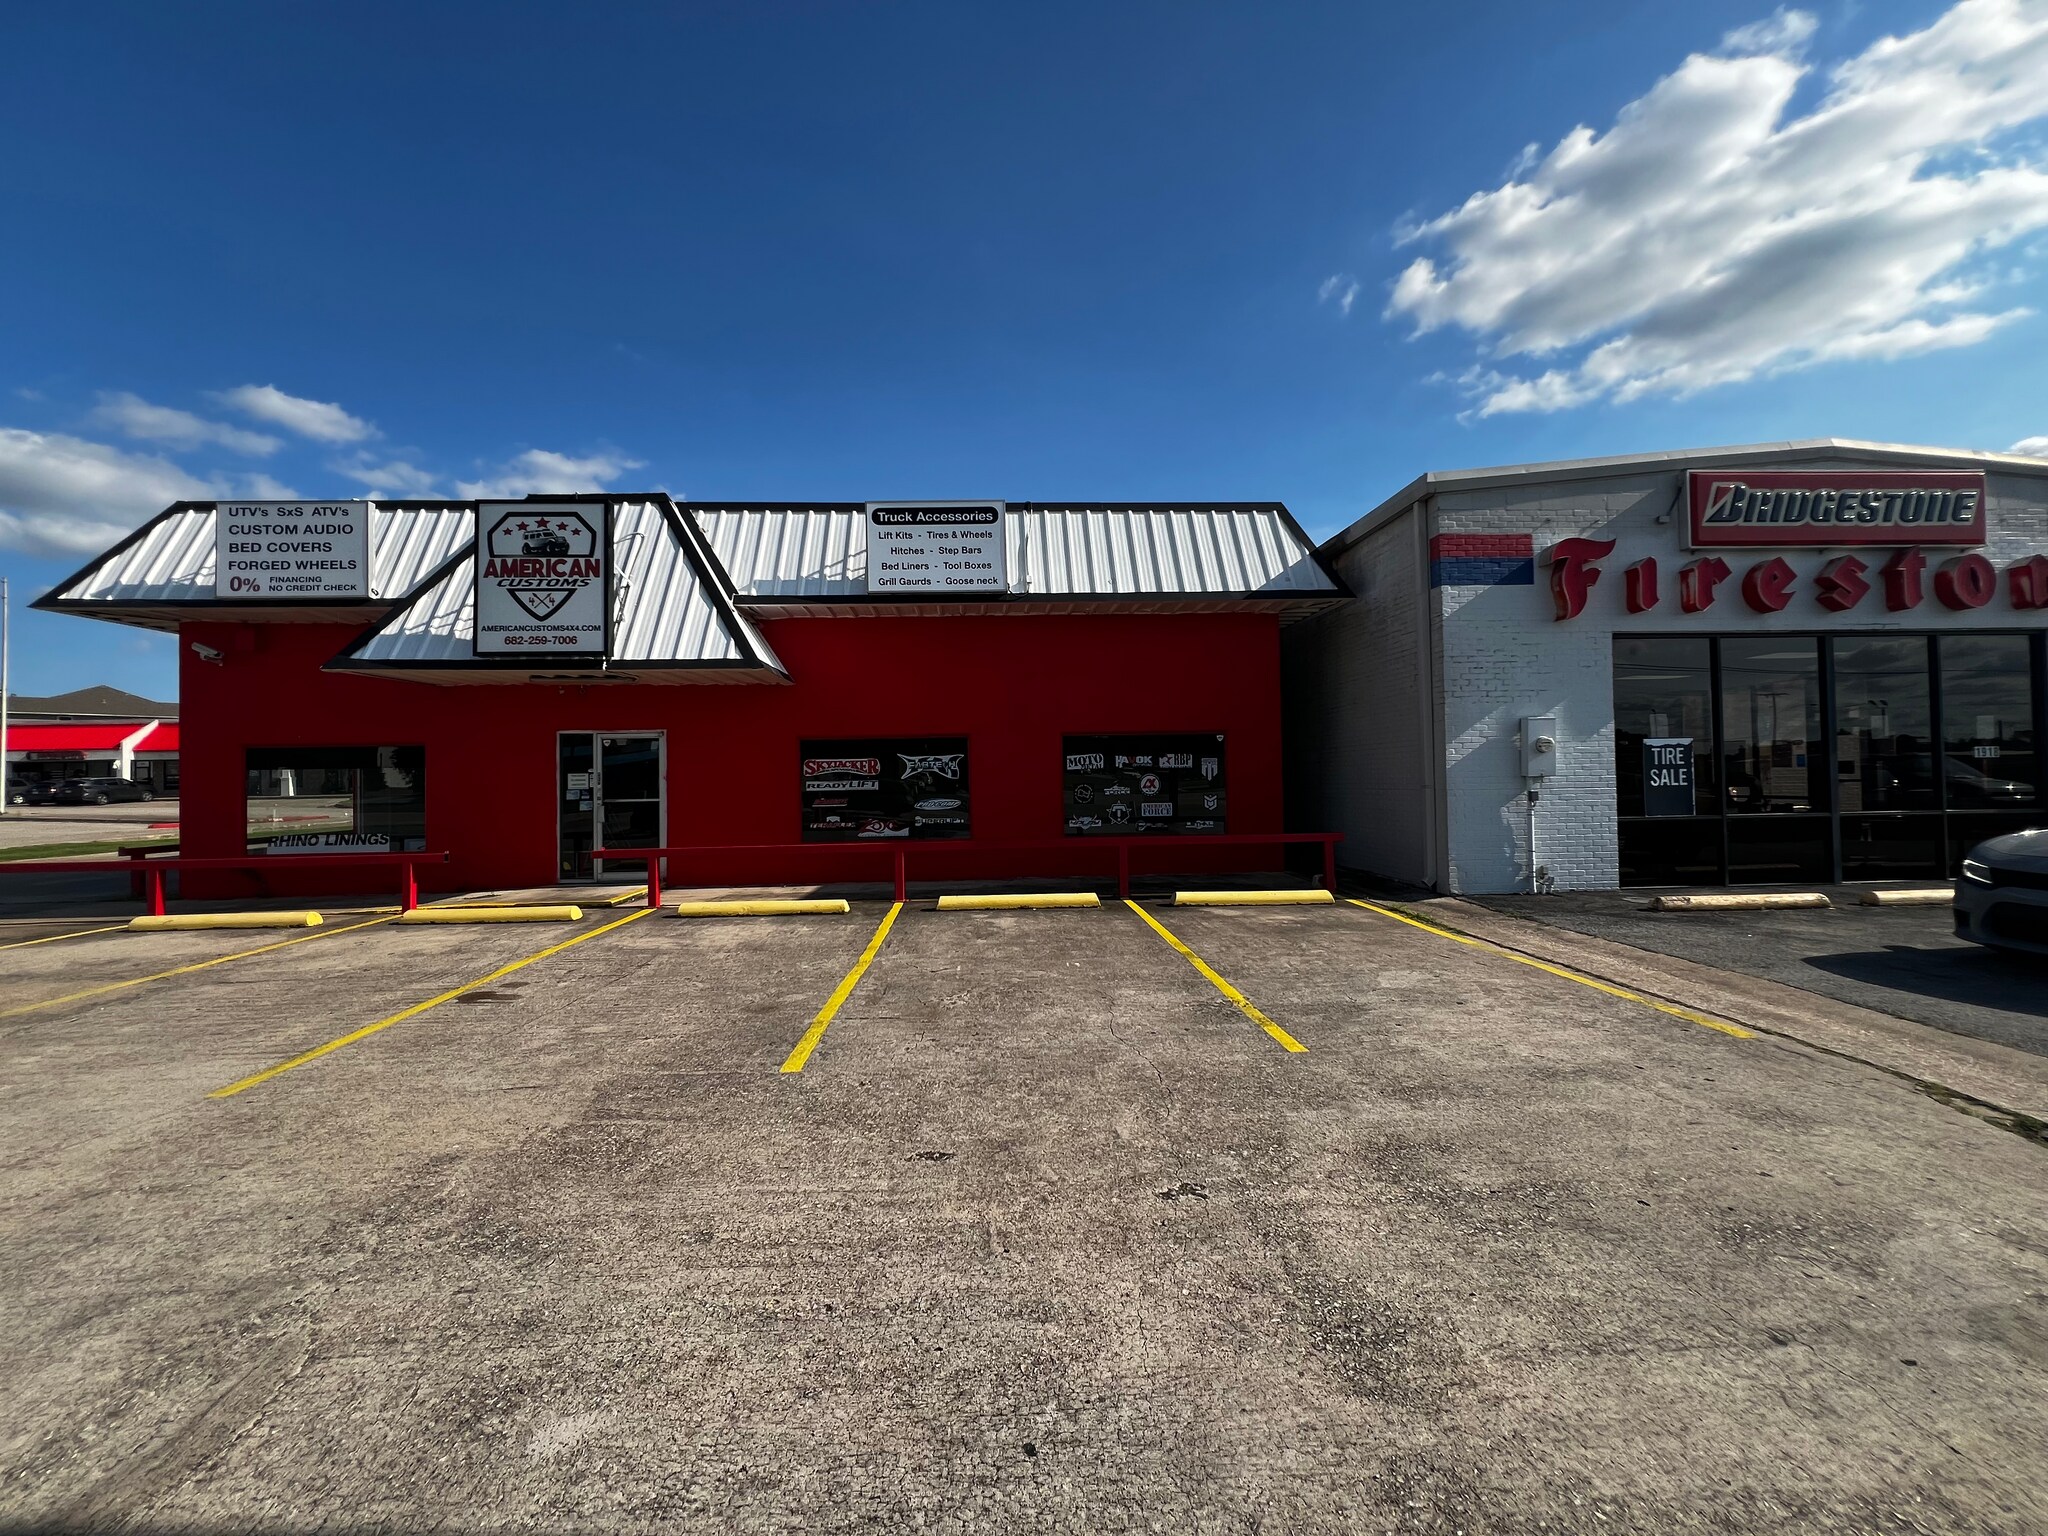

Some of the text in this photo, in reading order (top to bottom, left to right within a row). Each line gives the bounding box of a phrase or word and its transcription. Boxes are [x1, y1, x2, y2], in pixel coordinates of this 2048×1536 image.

[1703, 482, 1980, 526] BRIDGESTONE
[229, 506, 349, 517] UTV's SxS ATV's
[877, 511, 994, 522] Truck Accessories
[228, 524, 354, 535] CUSTOM AUDIO
[878, 531, 893, 540] Lift
[895, 531, 913, 540] Kits
[926, 531, 949, 539] Tires
[951, 531, 958, 539] &
[960, 530, 993, 539] Wheels
[229, 542, 333, 553] BED COVERS
[890, 546, 925, 555] Hitches
[938, 546, 959, 556] Step
[961, 546, 982, 555] Bars
[228, 560, 357, 571] FORGED WHEELS
[483, 558, 601, 579] AMERICAN
[881, 562, 899, 571] Bed
[901, 562, 930, 571] Liners
[943, 561, 962, 570] Tool
[964, 561, 992, 570] Boxes
[229, 576, 261, 592] 0%
[497, 578, 592, 587] CUSTOMS
[878, 577, 897, 586] Grill
[899, 577, 932, 586] Gaurds
[945, 577, 974, 585] Goose
[976, 576, 999, 585] neck
[285, 584, 321, 592] CREDIT
[481, 624, 601, 632] AMERICANCUSTOMS4X4.COM
[504, 635, 578, 645] 682-259-7006
[1651, 747, 1686, 765] TIRE
[804, 758, 879, 775] SKYJACKER
[1650, 768, 1688, 787] SALE
[268, 833, 390, 847] RHINO LININGS
